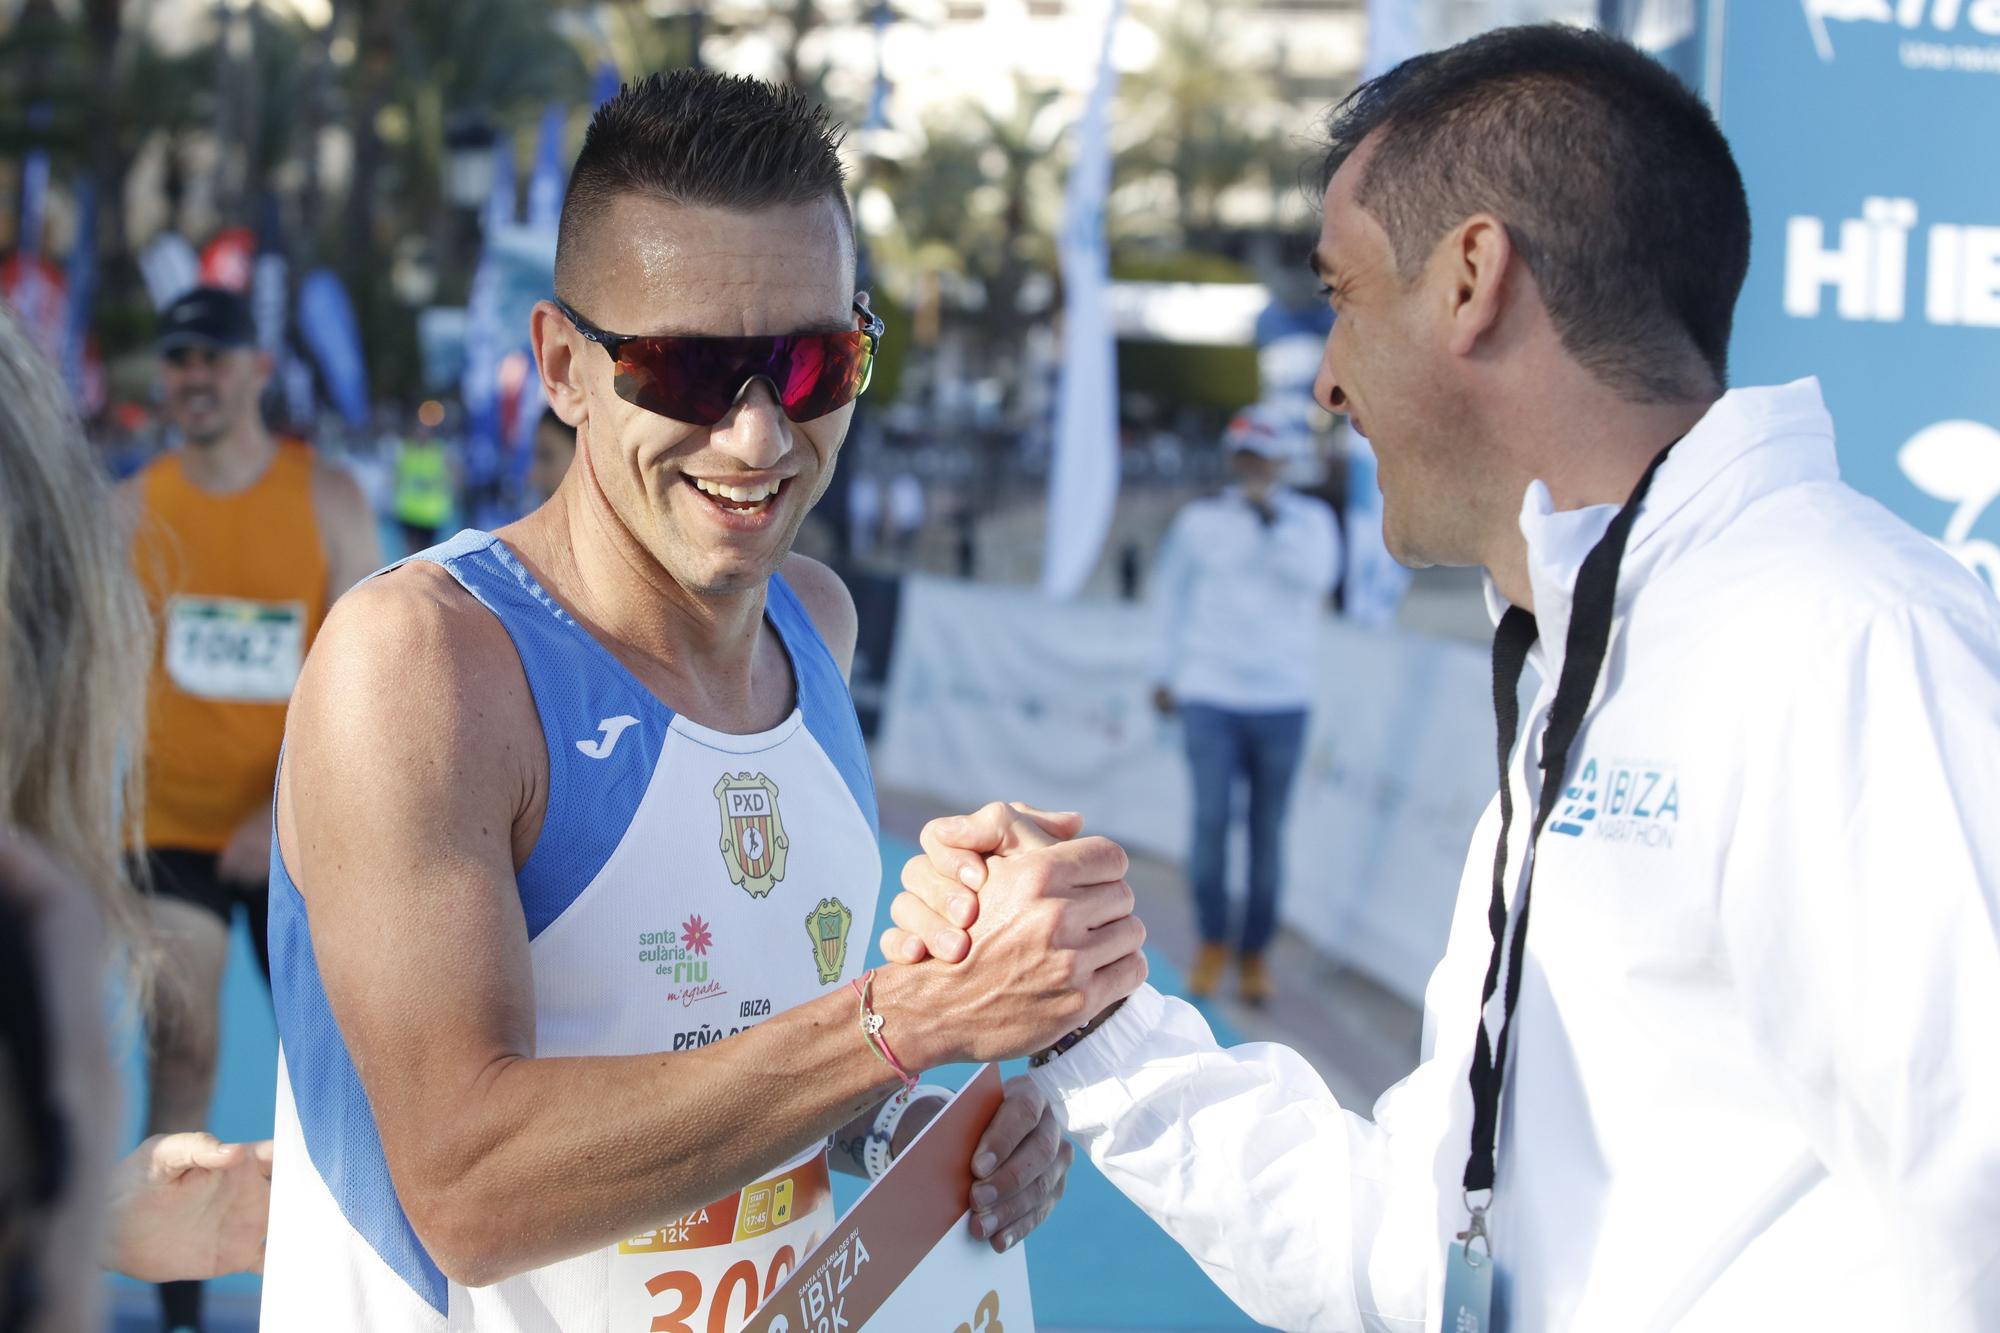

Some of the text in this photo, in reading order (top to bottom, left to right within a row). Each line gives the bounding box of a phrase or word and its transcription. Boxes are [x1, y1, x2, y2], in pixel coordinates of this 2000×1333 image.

[1783, 196, 1918, 321] HÏ
[733, 793, 764, 812] PXD
[1602, 769, 1679, 823] IBIZA
[639, 930, 676, 946] santa
[639, 945, 686, 962] eulària
[655, 955, 709, 983] des riu
[667, 979, 728, 1008] m'agrada
[739, 998, 771, 1018] IBIZA
[747, 1211, 766, 1227] 17:45
[777, 1204, 786, 1217] 40
[660, 1226, 690, 1244] 12K
[798, 1226, 859, 1298] SANTA EULÀRIA DES RIU
[800, 1236, 870, 1330] IBIZA
